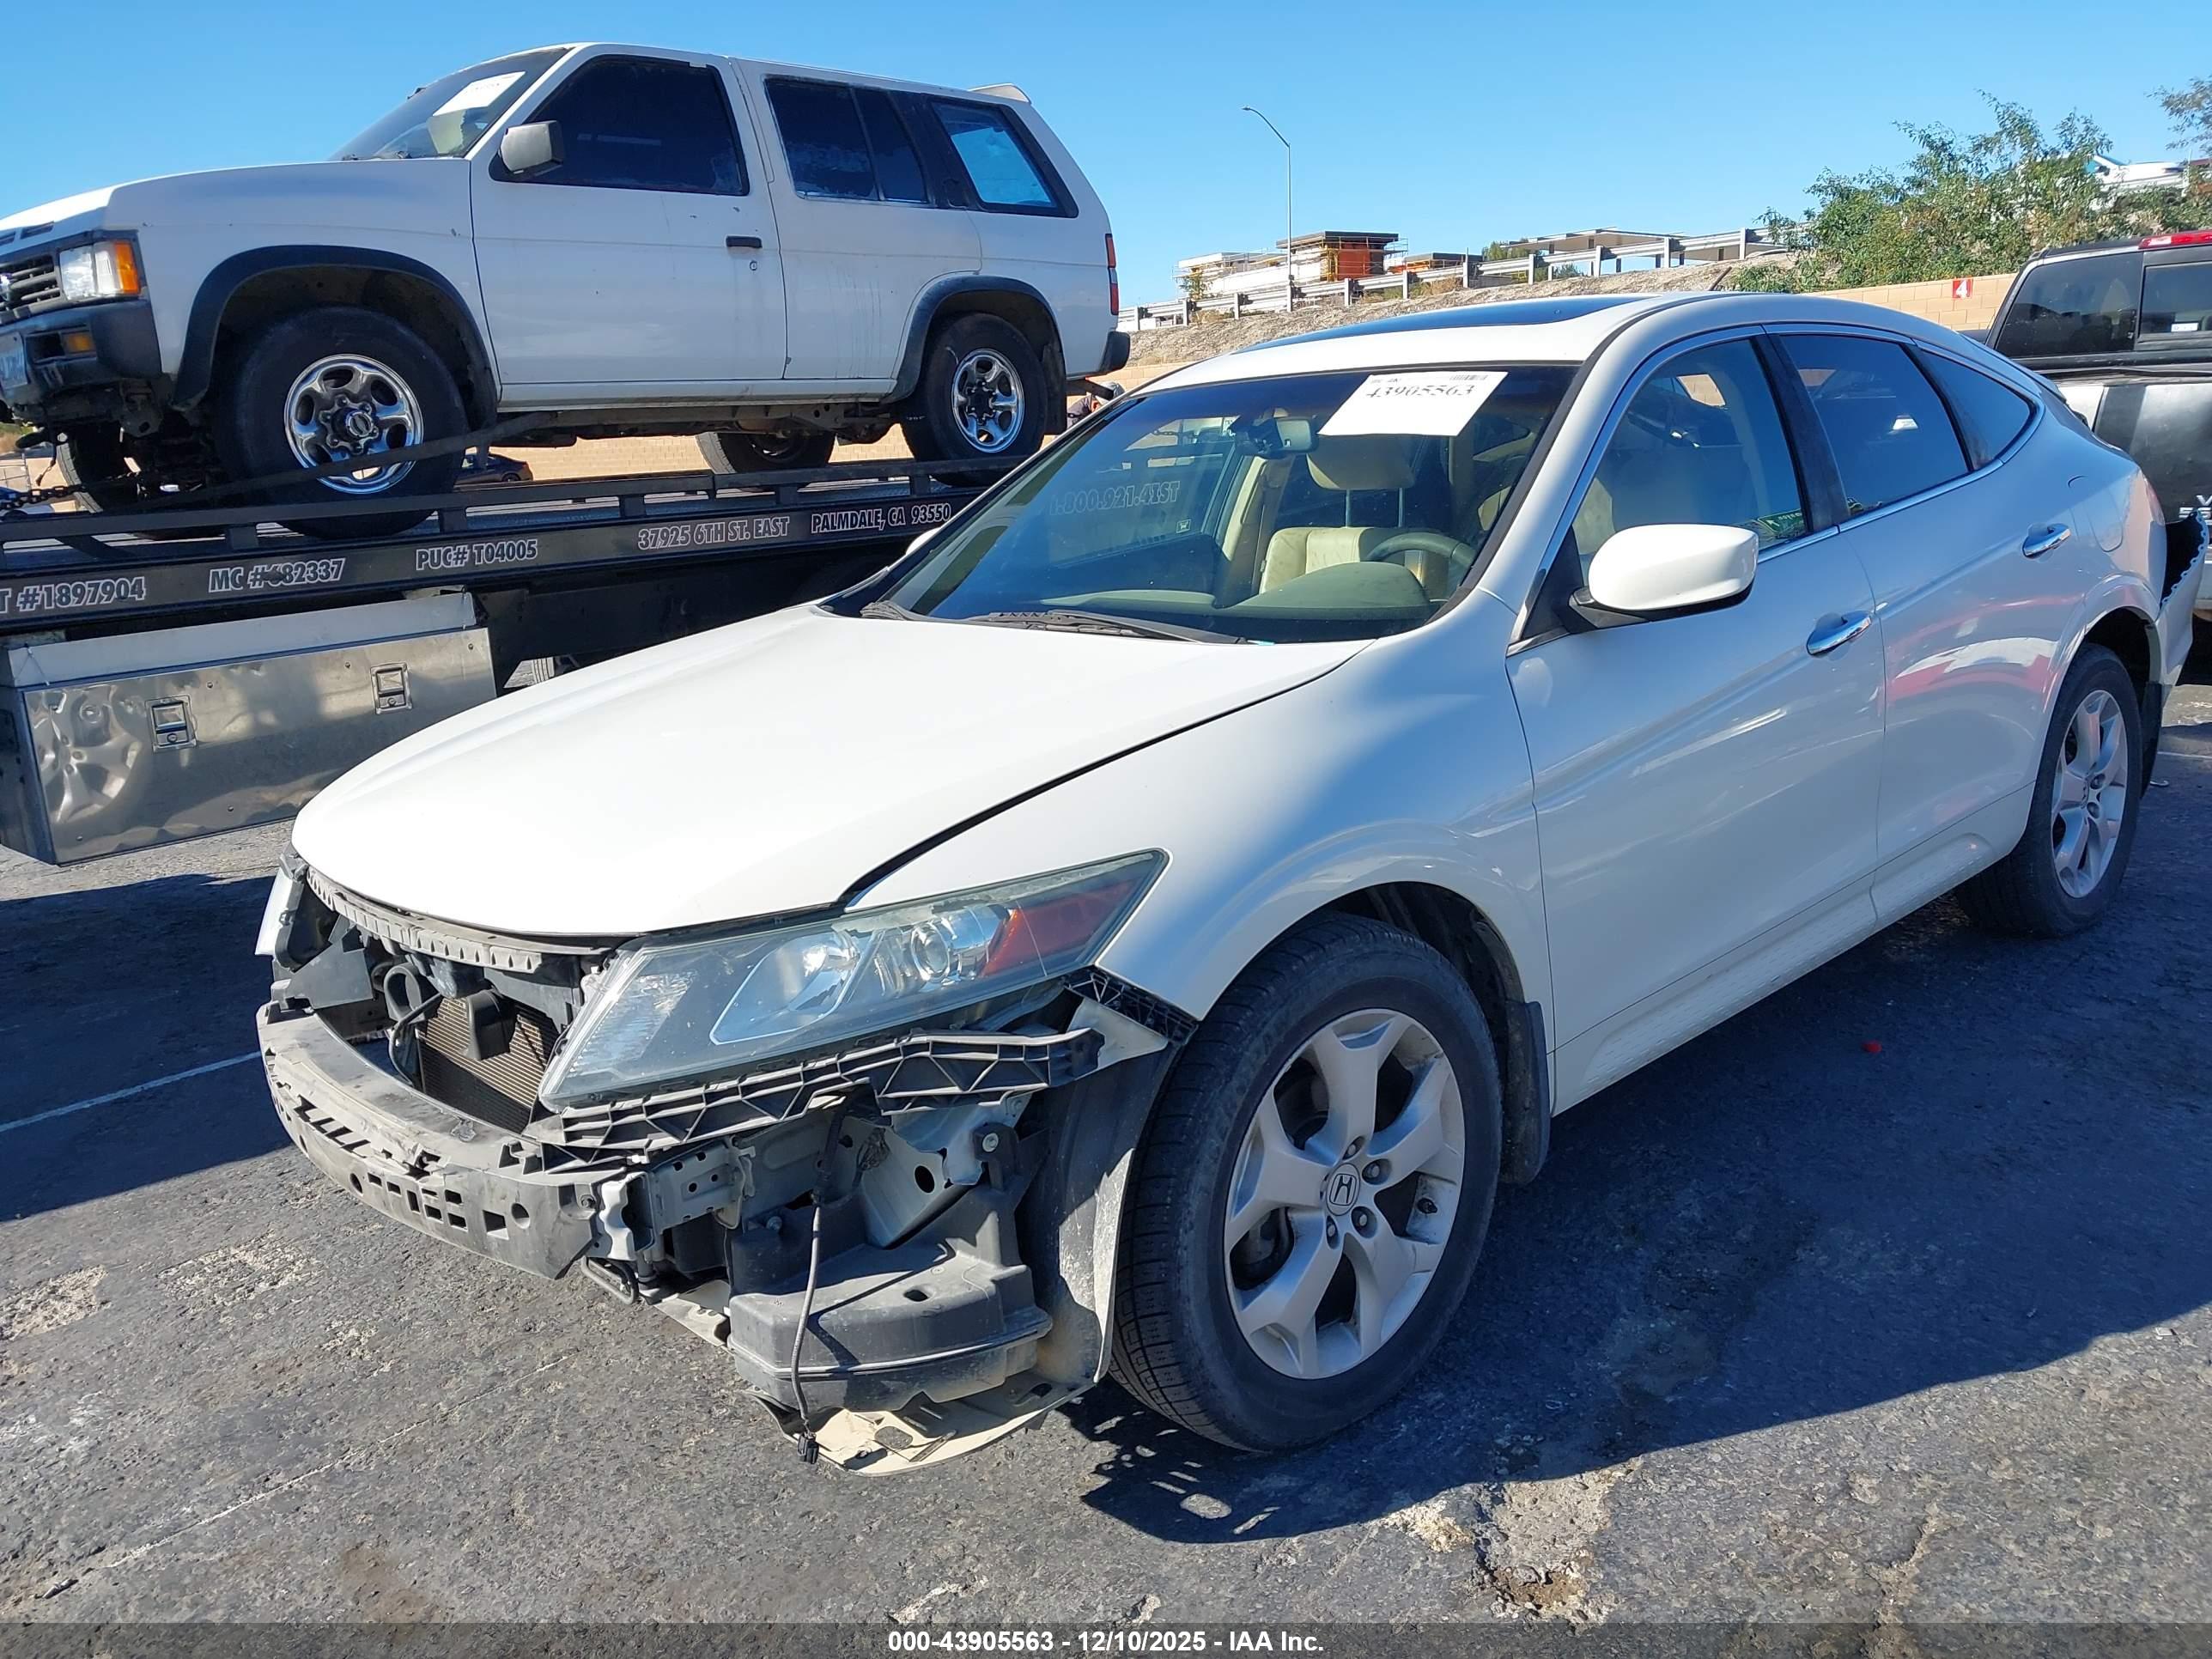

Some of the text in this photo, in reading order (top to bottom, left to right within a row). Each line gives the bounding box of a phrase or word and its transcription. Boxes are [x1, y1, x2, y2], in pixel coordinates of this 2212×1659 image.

[1956, 279, 1968, 300] 4
[638, 516, 790, 550] 37925 6TH ST. EAST
[811, 503, 951, 534] PALMDALE, CA 93550
[416, 539, 538, 570] PUC# T04005
[16, 576, 146, 611] #1897904
[209, 567, 244, 592] MC
